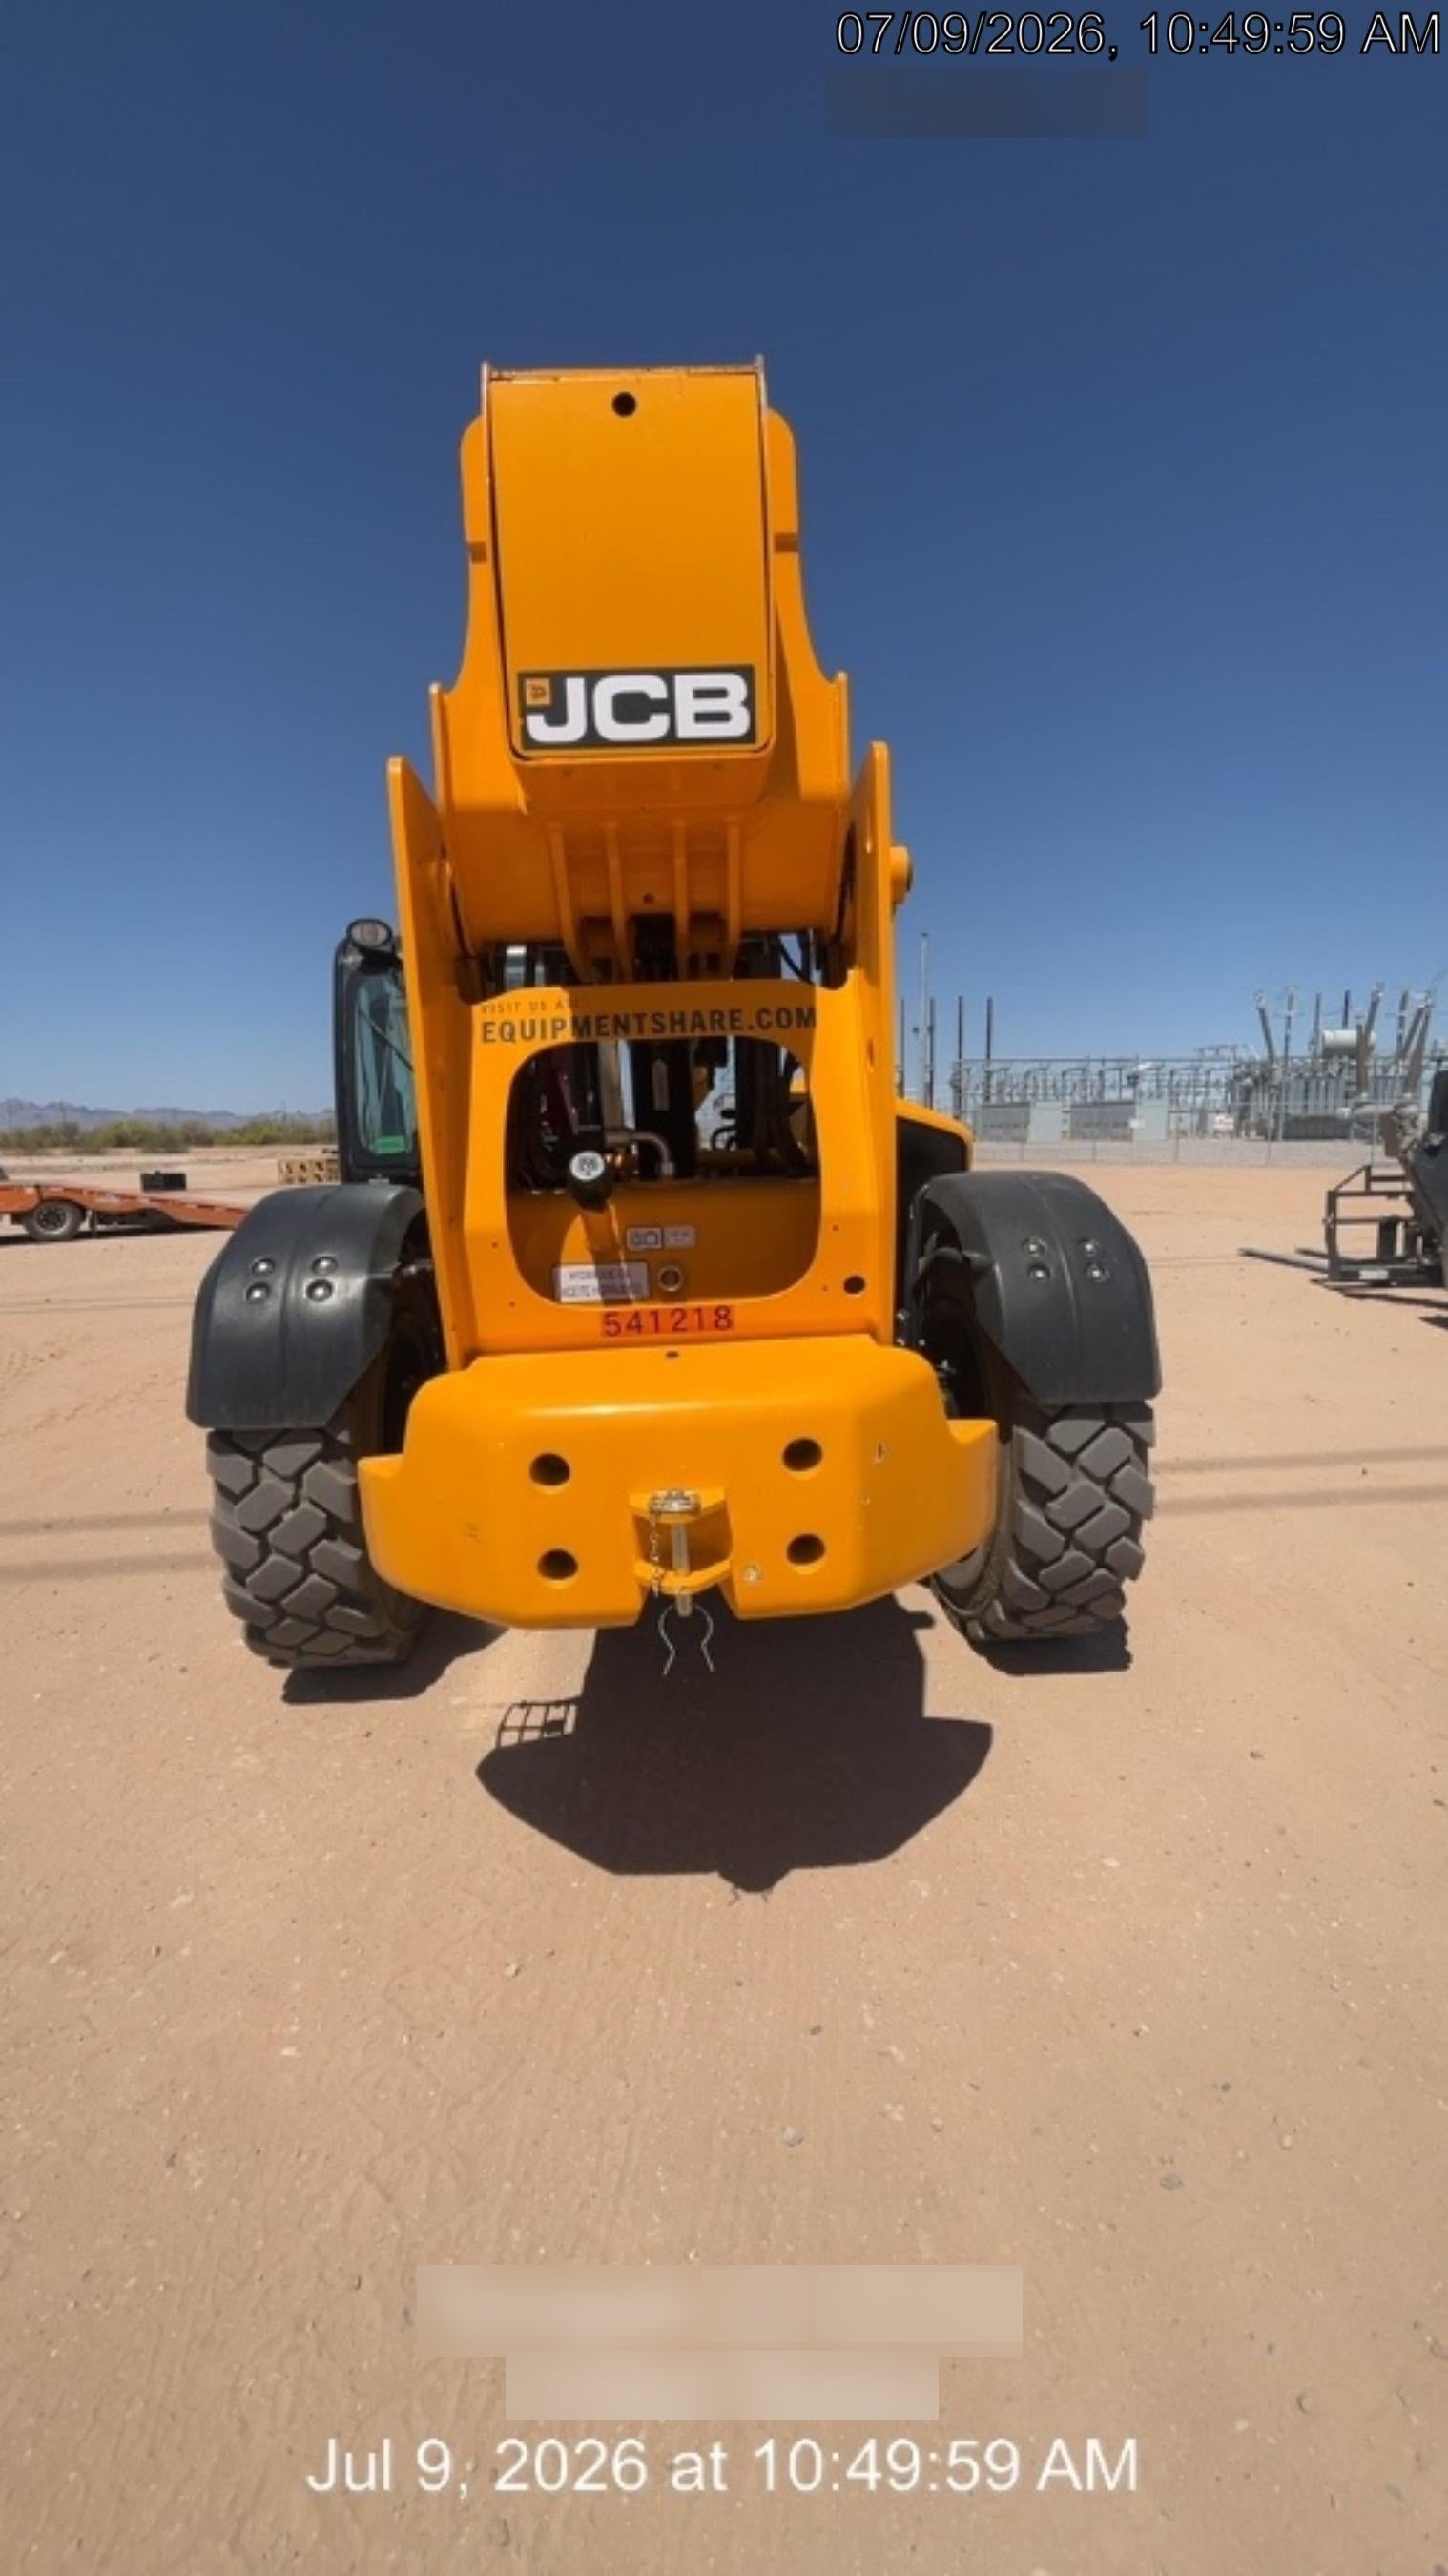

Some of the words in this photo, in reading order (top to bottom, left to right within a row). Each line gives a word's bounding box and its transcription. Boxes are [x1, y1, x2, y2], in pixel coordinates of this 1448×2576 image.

[526, 673, 751, 743] JCB
[482, 1007, 817, 1043] EQUIPMENTSHARE.COM
[605, 1305, 733, 1337] 541218
